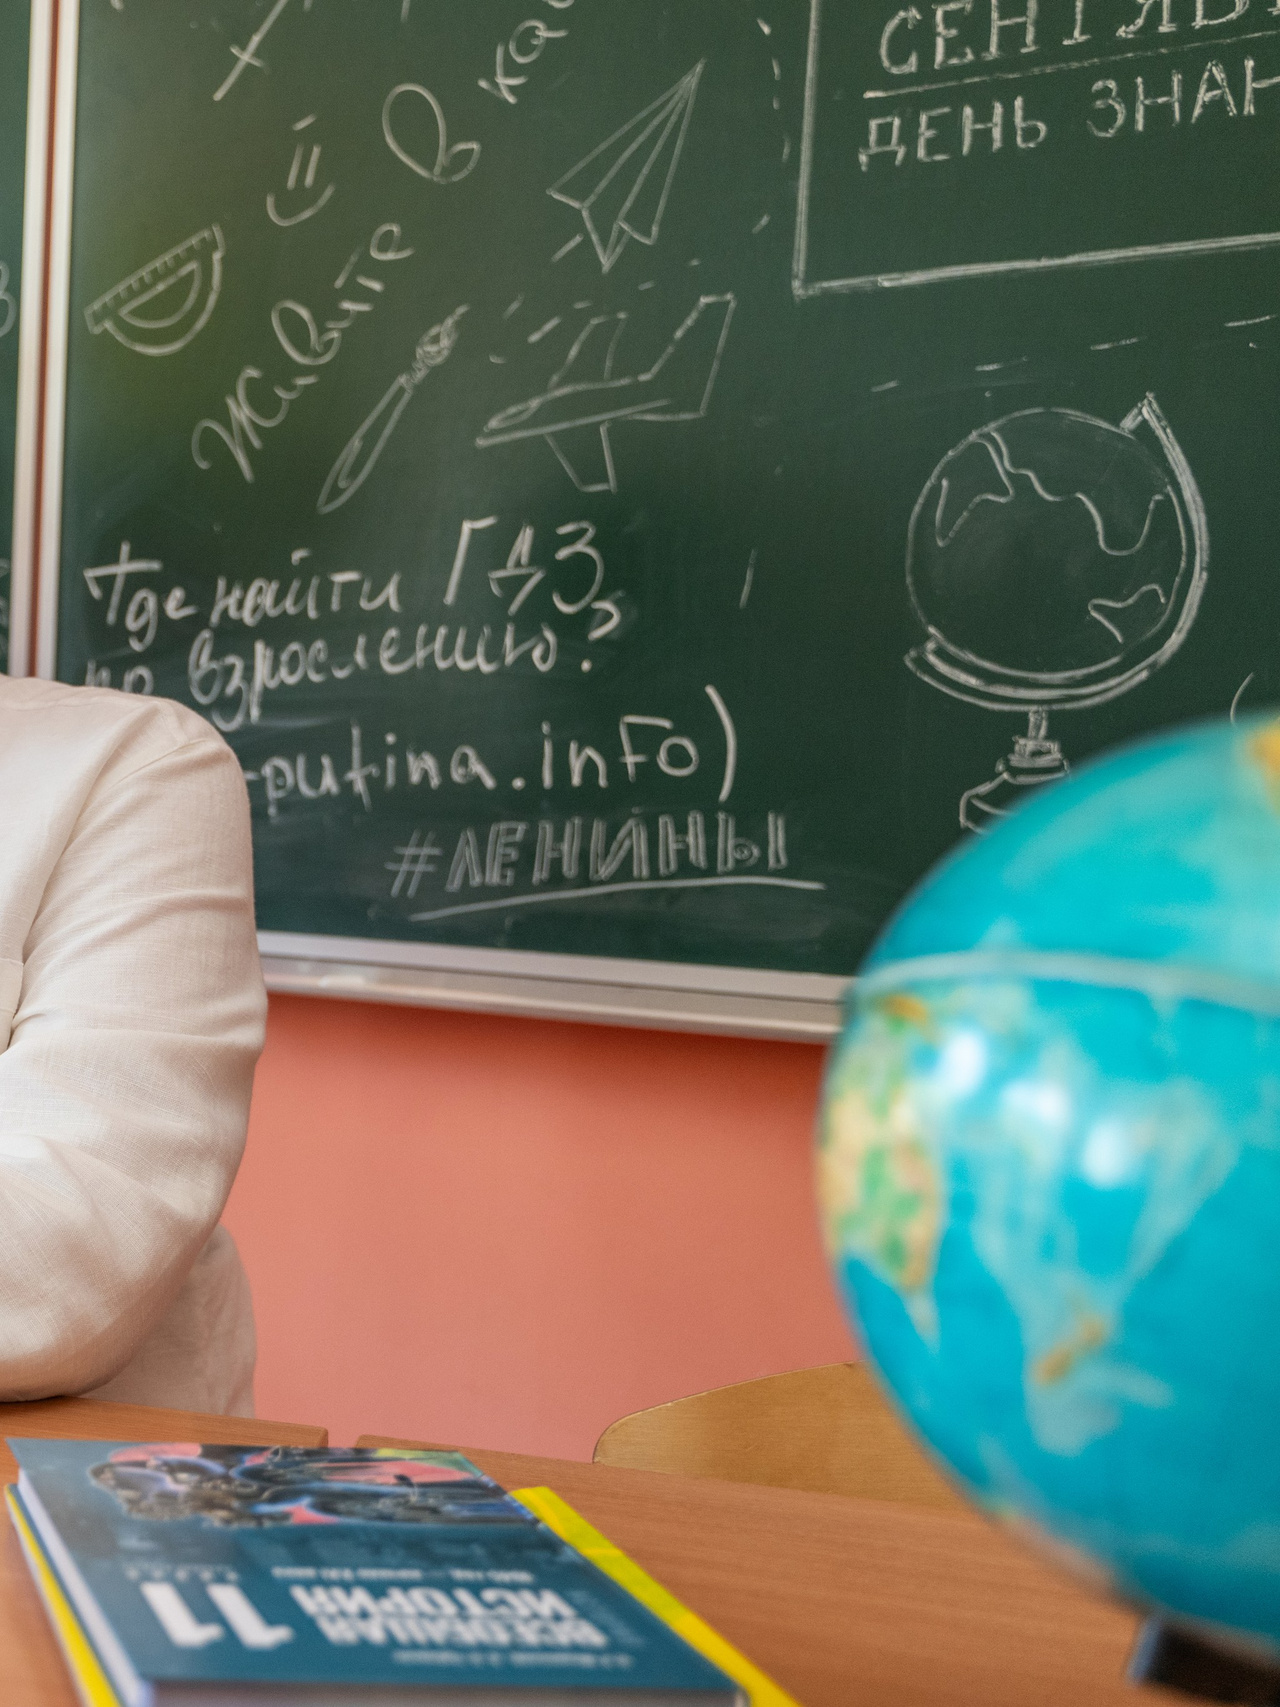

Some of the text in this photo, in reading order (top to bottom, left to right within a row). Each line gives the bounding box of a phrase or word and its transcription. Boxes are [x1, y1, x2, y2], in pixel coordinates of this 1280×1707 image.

[858, 95, 1047, 171] ДЕНЬ
[212, 549, 401, 627] найти
[139, 1581, 293, 1649] 11
